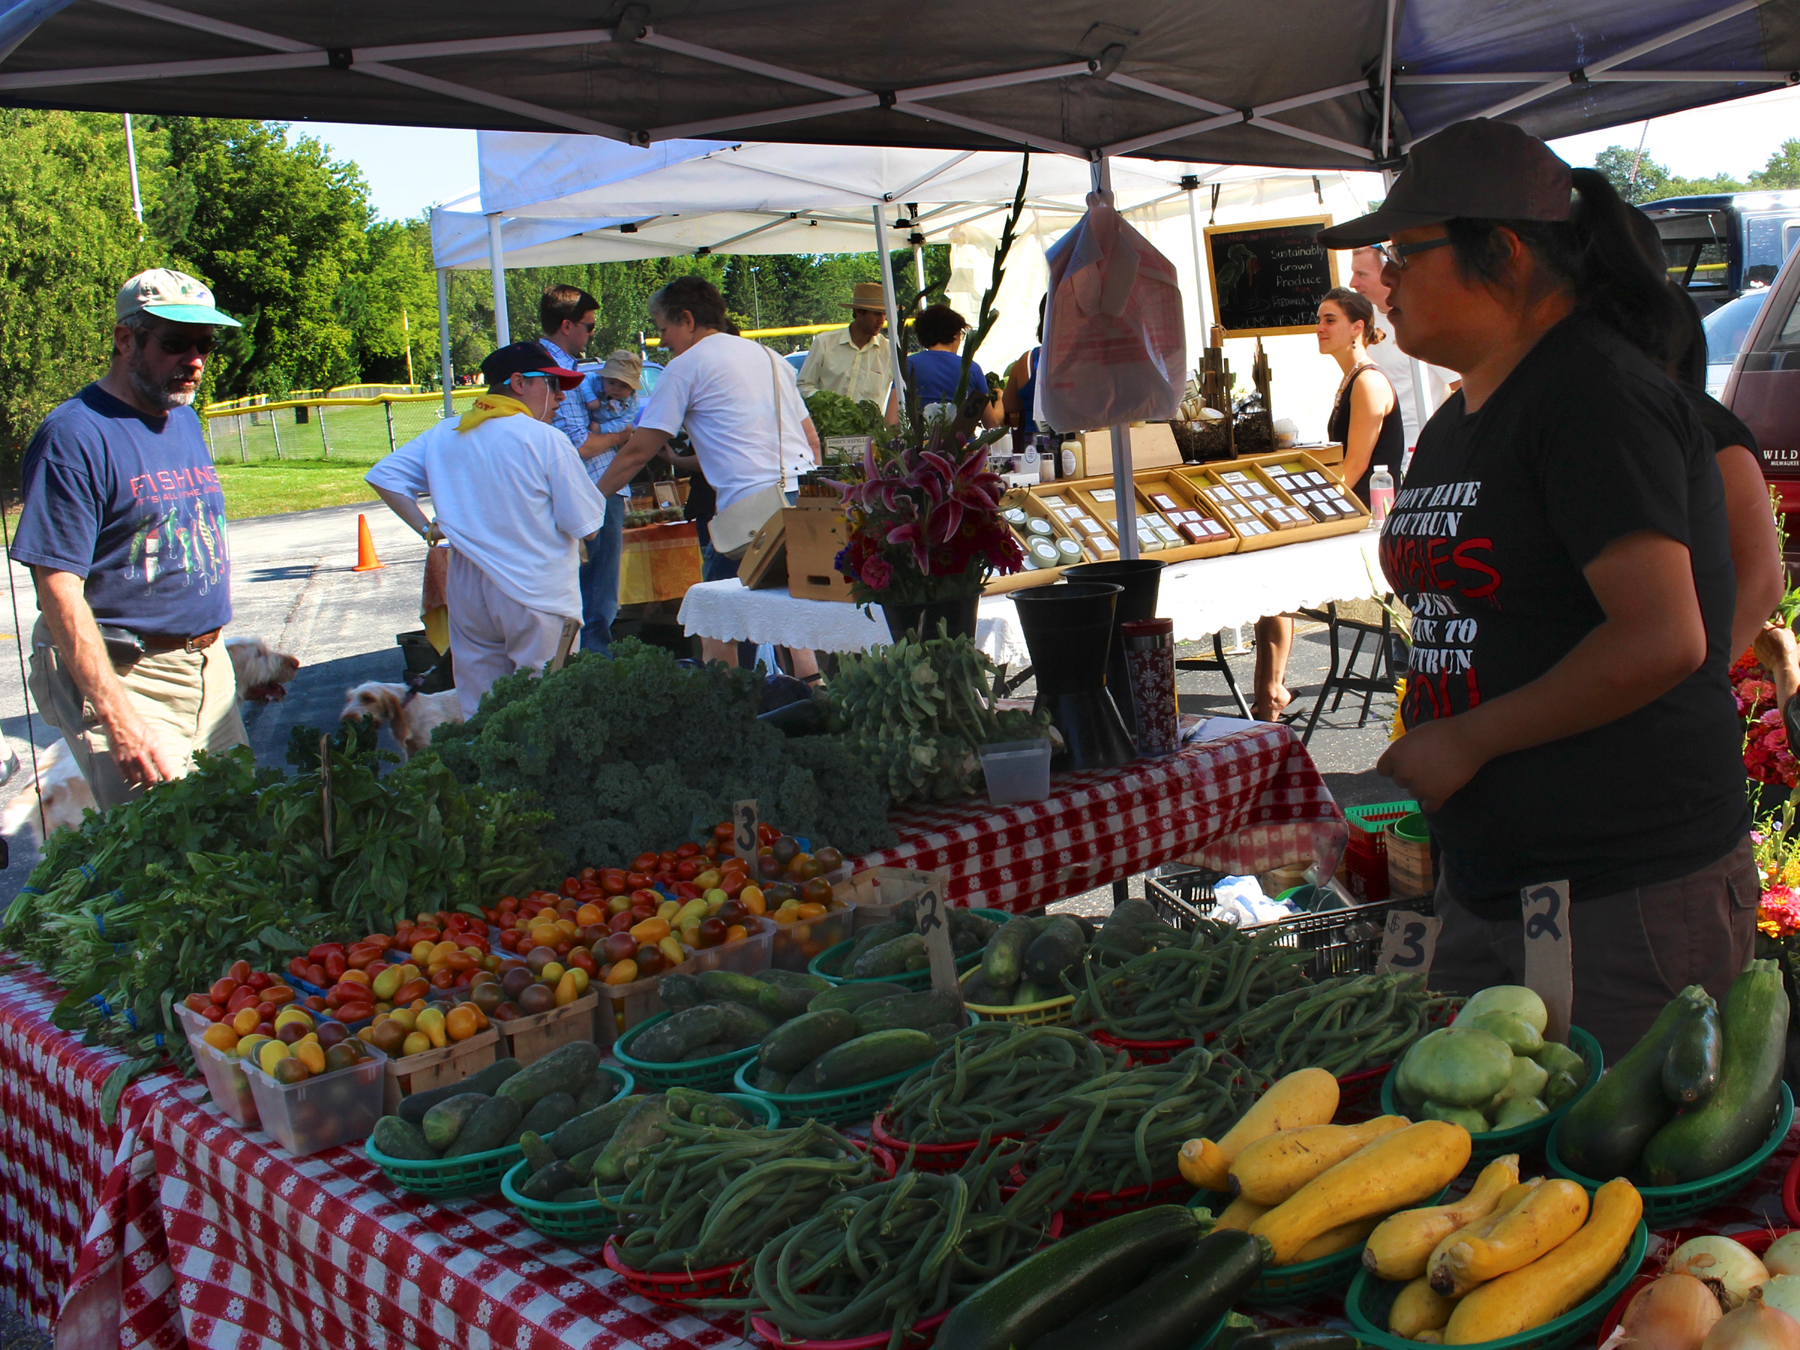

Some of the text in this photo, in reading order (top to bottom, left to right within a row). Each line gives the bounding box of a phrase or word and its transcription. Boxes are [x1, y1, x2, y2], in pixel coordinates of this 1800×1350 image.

[1271, 245, 1325, 260] Sustainably
[1280, 263, 1313, 272] Grown
[1276, 275, 1322, 287] Produce
[1300, 311, 1319, 325] FA
[1763, 450, 1799, 459] WILD
[1427, 481, 1481, 508] HAVE
[1391, 511, 1464, 538] OUTRUN
[1410, 592, 1461, 616] JUST
[1444, 617, 1478, 644] TO
